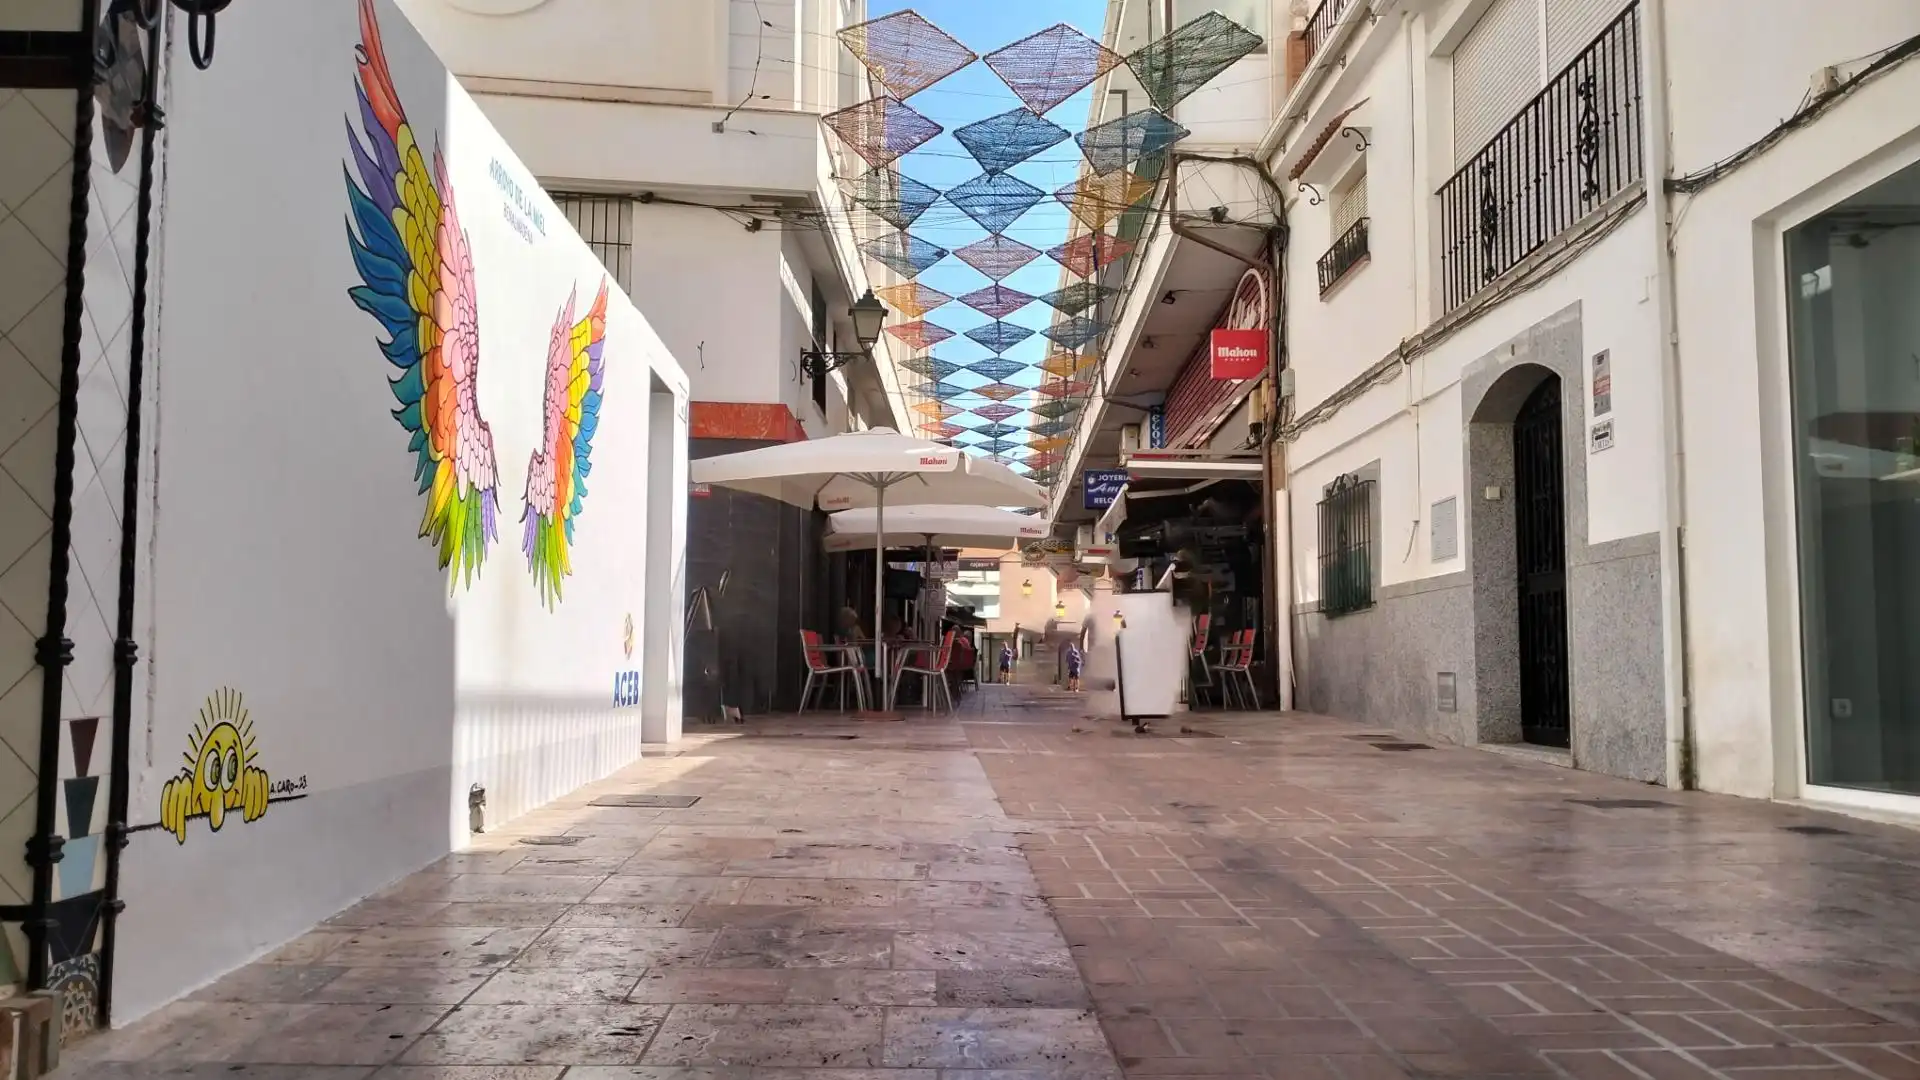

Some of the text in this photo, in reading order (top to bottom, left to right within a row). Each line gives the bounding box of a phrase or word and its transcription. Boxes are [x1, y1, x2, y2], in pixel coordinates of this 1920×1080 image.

[515, 184, 523, 210] DE
[524, 195, 533, 221] LA
[1217, 346, 1258, 358] Mahou
[920, 457, 948, 465] Mahou
[613, 670, 639, 708] ACEB
